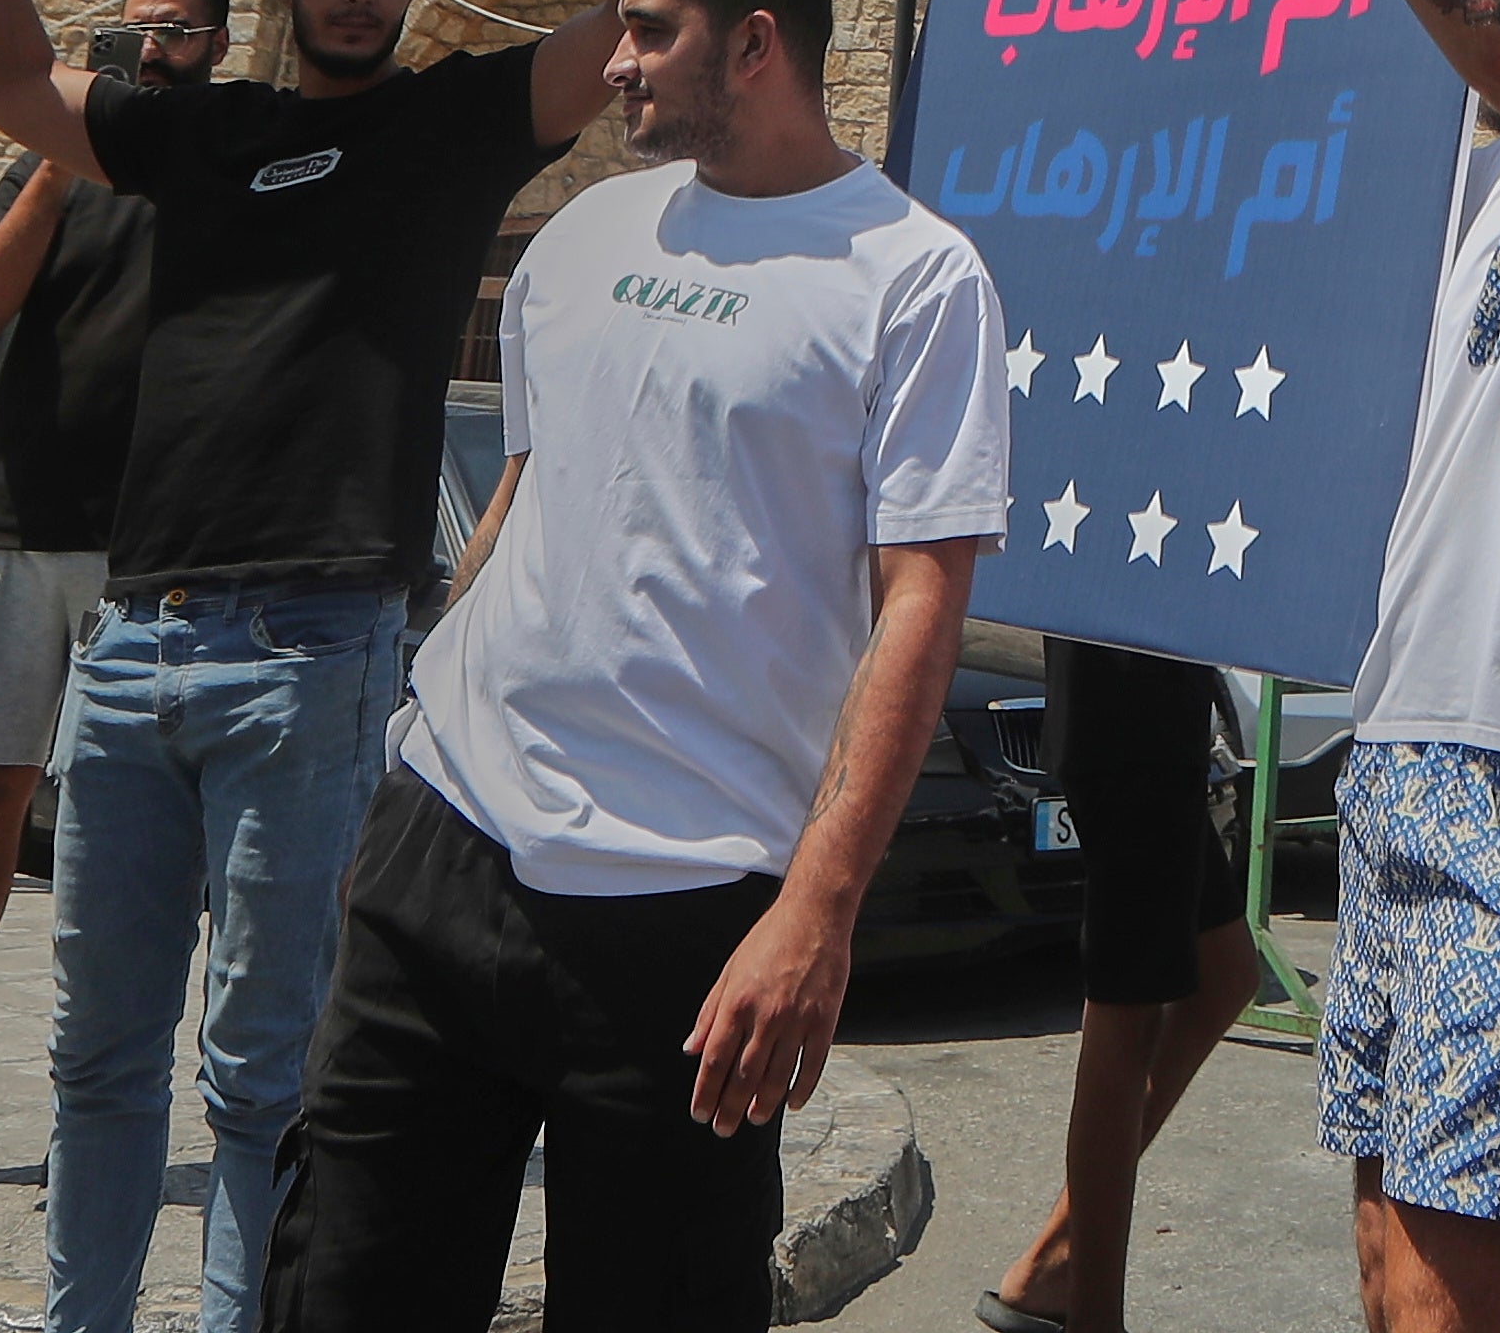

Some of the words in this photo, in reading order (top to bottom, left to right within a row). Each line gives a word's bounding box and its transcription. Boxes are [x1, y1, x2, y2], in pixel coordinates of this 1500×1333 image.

[938, 115, 1230, 257] الإرهاب
[1227, 89, 1355, 280] أم
[1056, 806, 1072, 843] S
